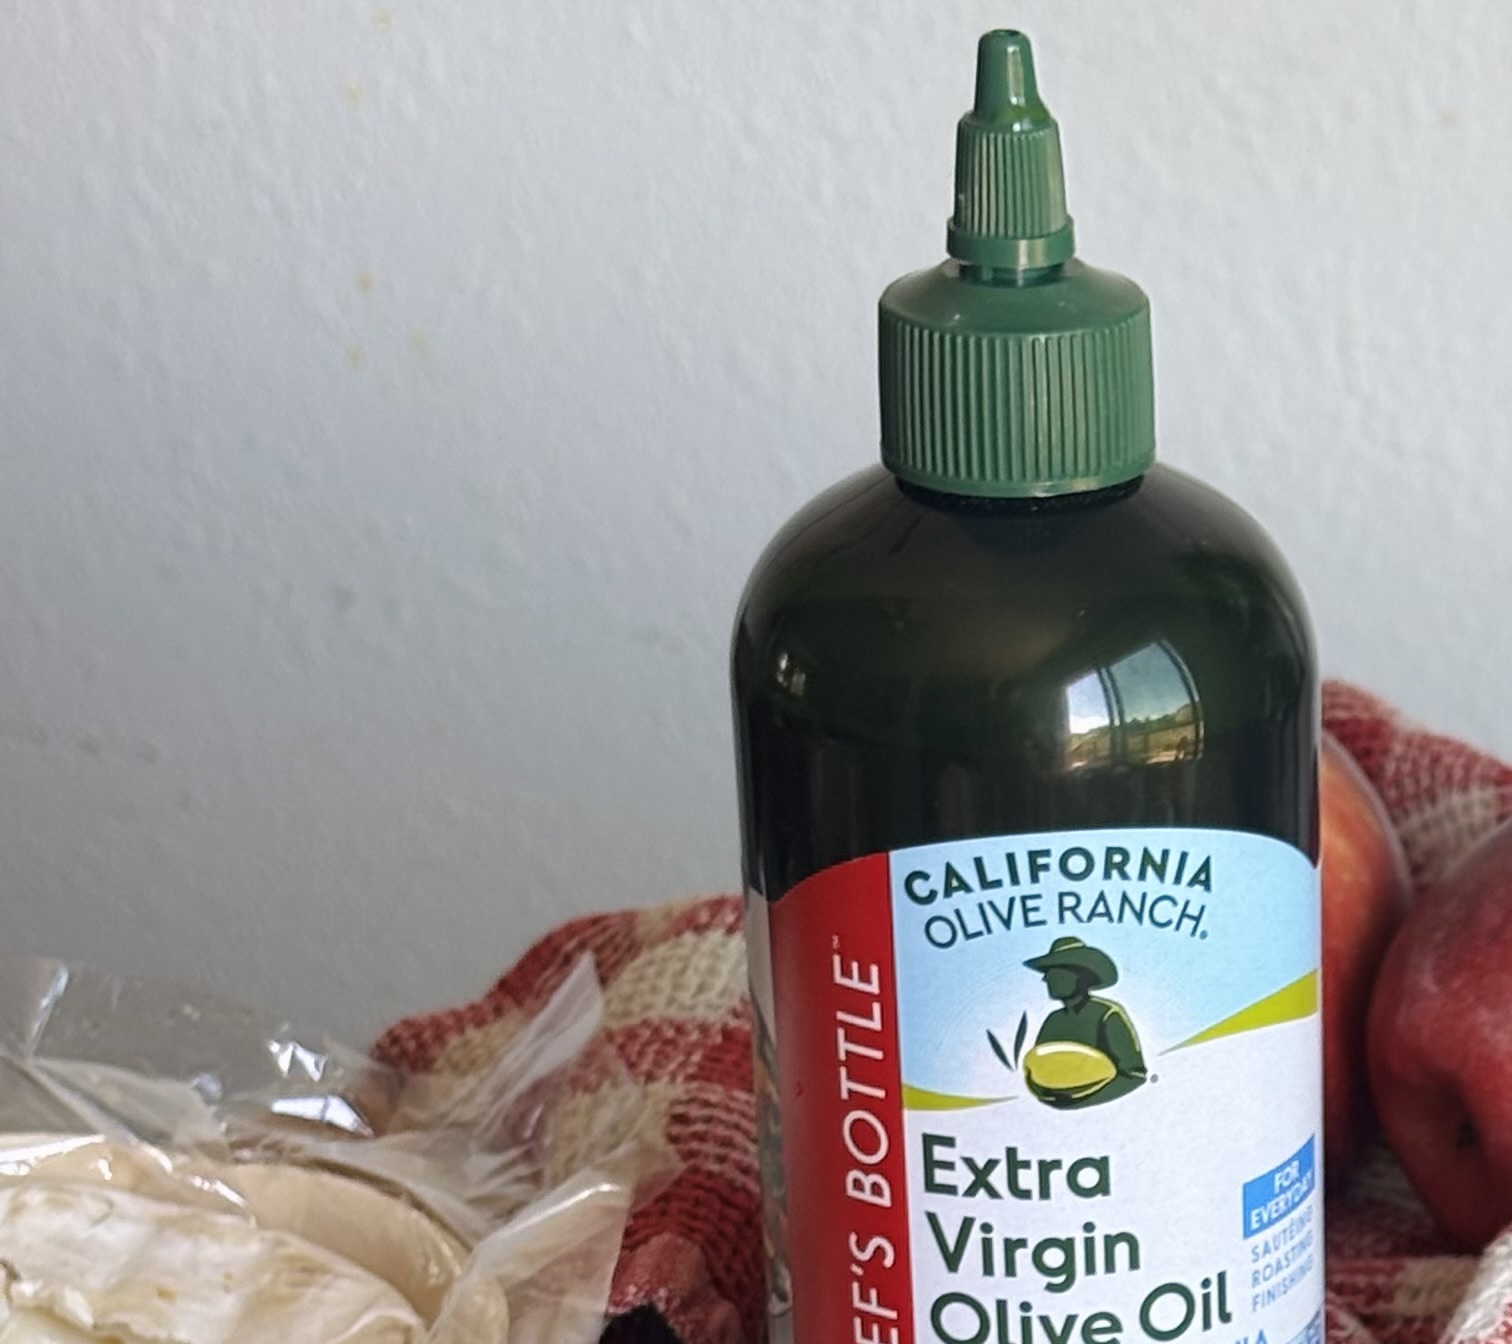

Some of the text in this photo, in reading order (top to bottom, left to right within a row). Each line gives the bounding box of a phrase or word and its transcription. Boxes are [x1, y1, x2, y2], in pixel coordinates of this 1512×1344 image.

[904, 846, 1212, 905] CALIFORNIA
[924, 889, 1206, 949] OLIVE RANCH
[833, 953, 893, 1207] BOTTLE
[922, 1132, 1111, 1201] Extra
[1251, 1168, 1313, 1230] EVERYDAY
[1274, 1160, 1300, 1194] FOR
[924, 1210, 1141, 1294] Virgin
[1140, 1270, 1232, 1342] Oil
